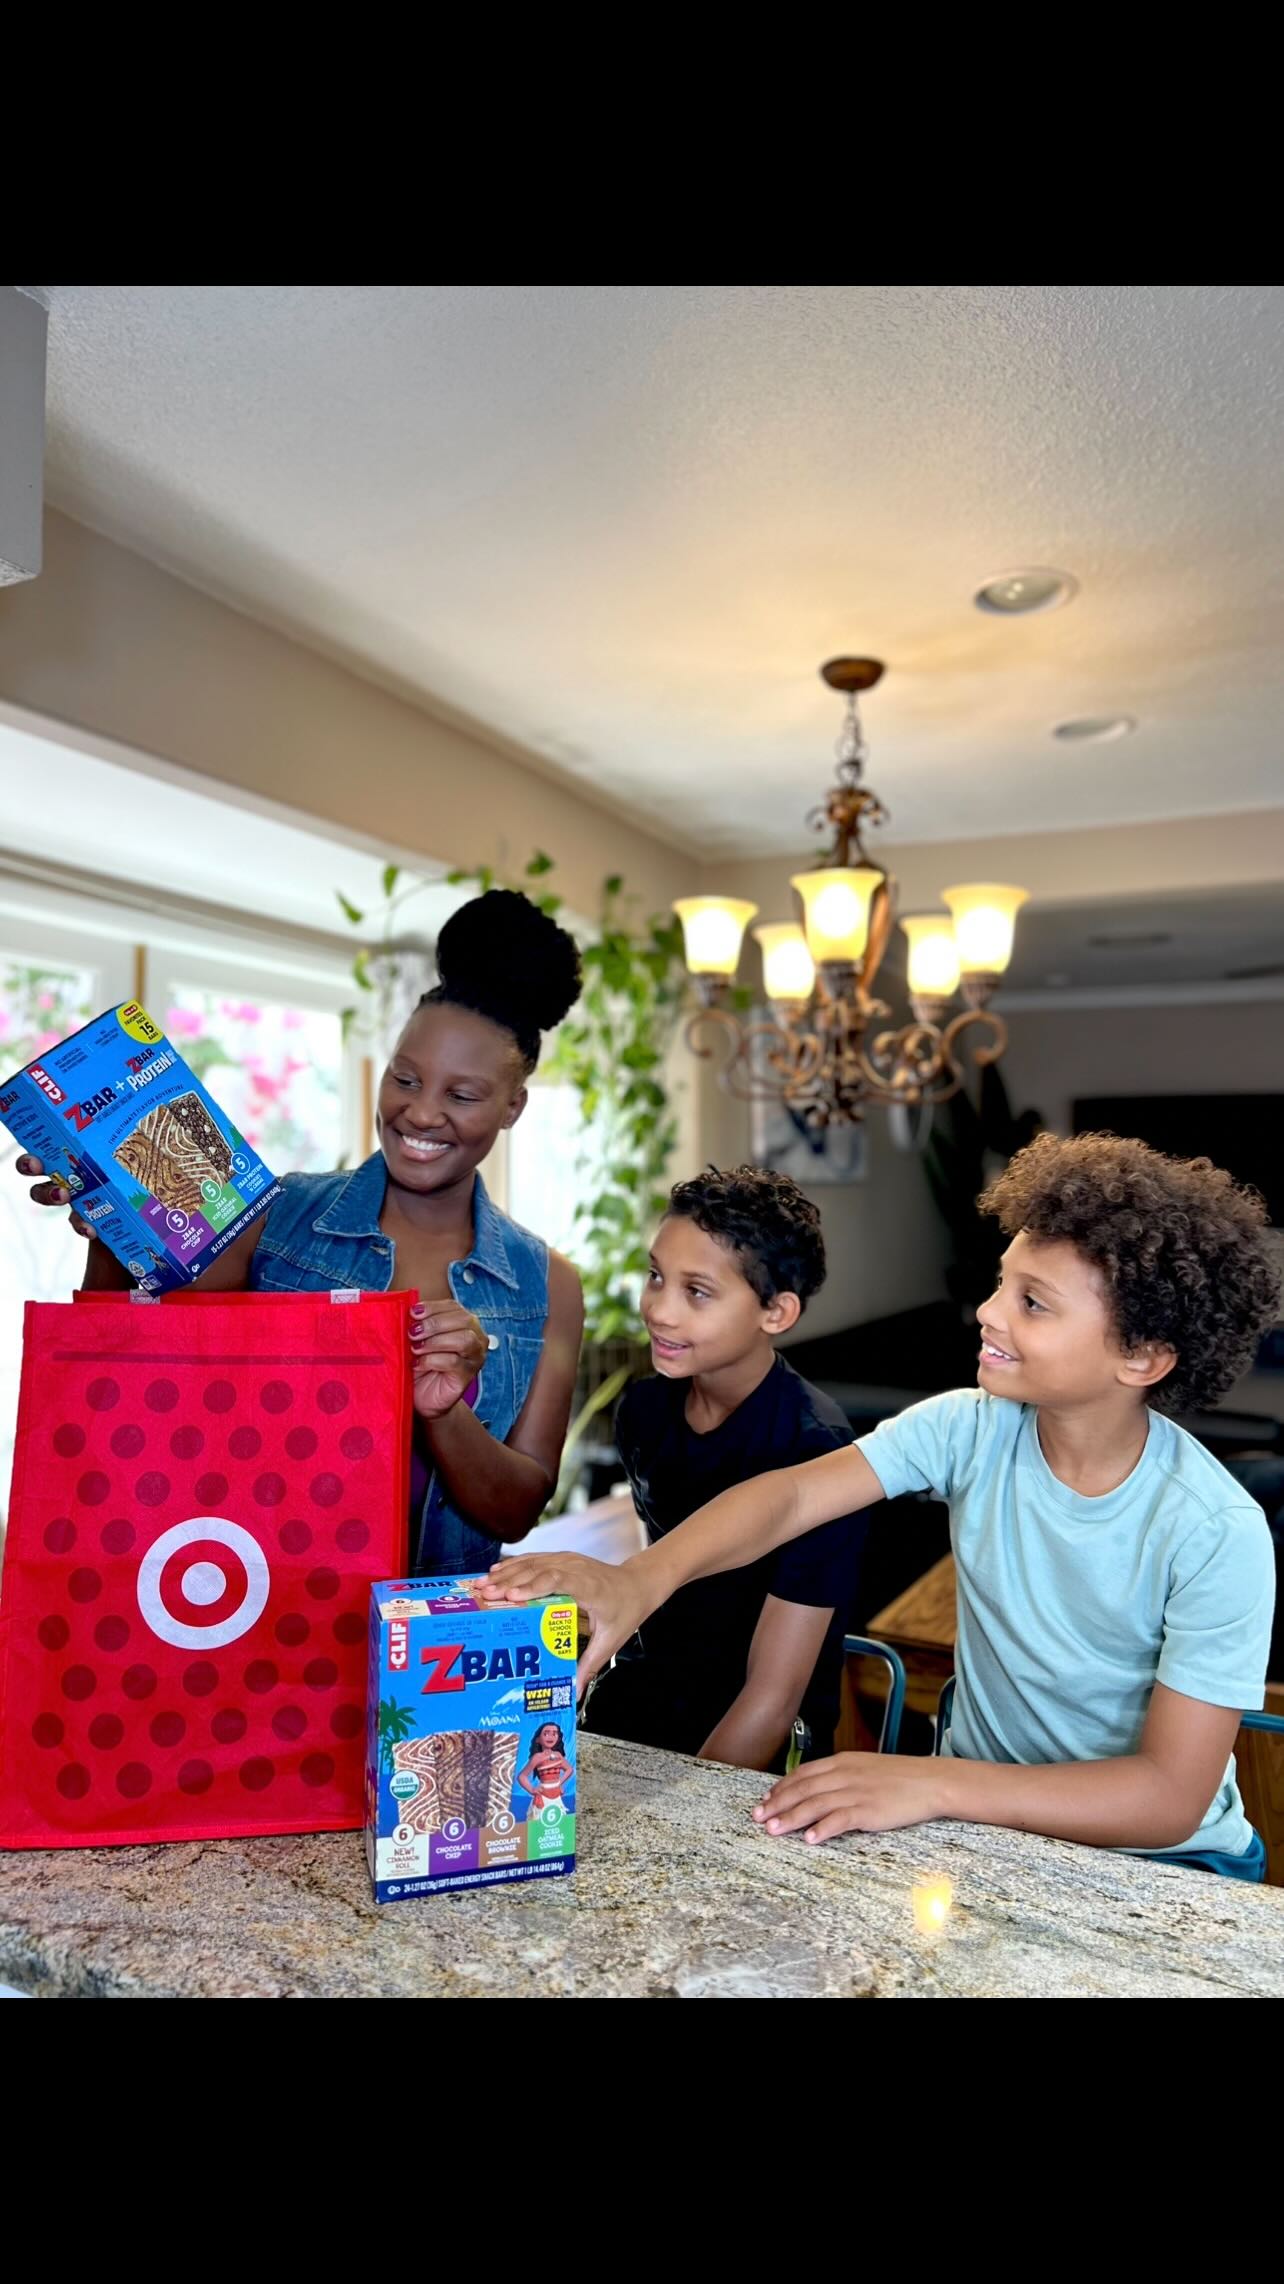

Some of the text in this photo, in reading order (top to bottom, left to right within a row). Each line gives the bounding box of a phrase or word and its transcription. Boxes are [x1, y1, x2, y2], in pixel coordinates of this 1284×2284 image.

[139, 1021, 155, 1036] 15
[127, 1048, 155, 1073] ZBAR
[126, 1051, 173, 1091] PROTEIN
[30, 1069, 62, 1101] CLIF
[63, 1087, 117, 1132] ZBAR
[116, 1110, 138, 1133] ULTIMATE
[136, 1098, 155, 1114] FLAVOR
[155, 1084, 184, 1101] ADVENTURE
[236, 1157, 246, 1169] 5
[205, 1184, 216, 1197] 5
[84, 1199, 115, 1221] PROTEIN
[171, 1213, 184, 1228] 5
[181, 1226, 196, 1241] ZBAR
[181, 1227, 204, 1250] CHOCOLATE
[191, 1237, 201, 1248] CHIP
[391, 1622, 406, 1666] CLIF
[554, 1637, 572, 1650] 24
[421, 1644, 541, 1694] ZBAR
[526, 1688, 551, 1700] WIN
[479, 1714, 520, 1727] MOANA
[547, 1809, 555, 1822] 6
[449, 1822, 459, 1836] 6
[499, 1816, 508, 1829] 6
[399, 1828, 408, 1841] 6
[538, 1833, 564, 1843] OATMEAL
[486, 1836, 520, 1847] CHOCOLATE
[539, 1840, 562, 1849] COOKIE
[435, 1843, 472, 1854] CHOCOLATE
[488, 1844, 517, 1854] BROWNIE
[387, 1855, 420, 1864] CINNAMON
[445, 1851, 461, 1860] CHIP
